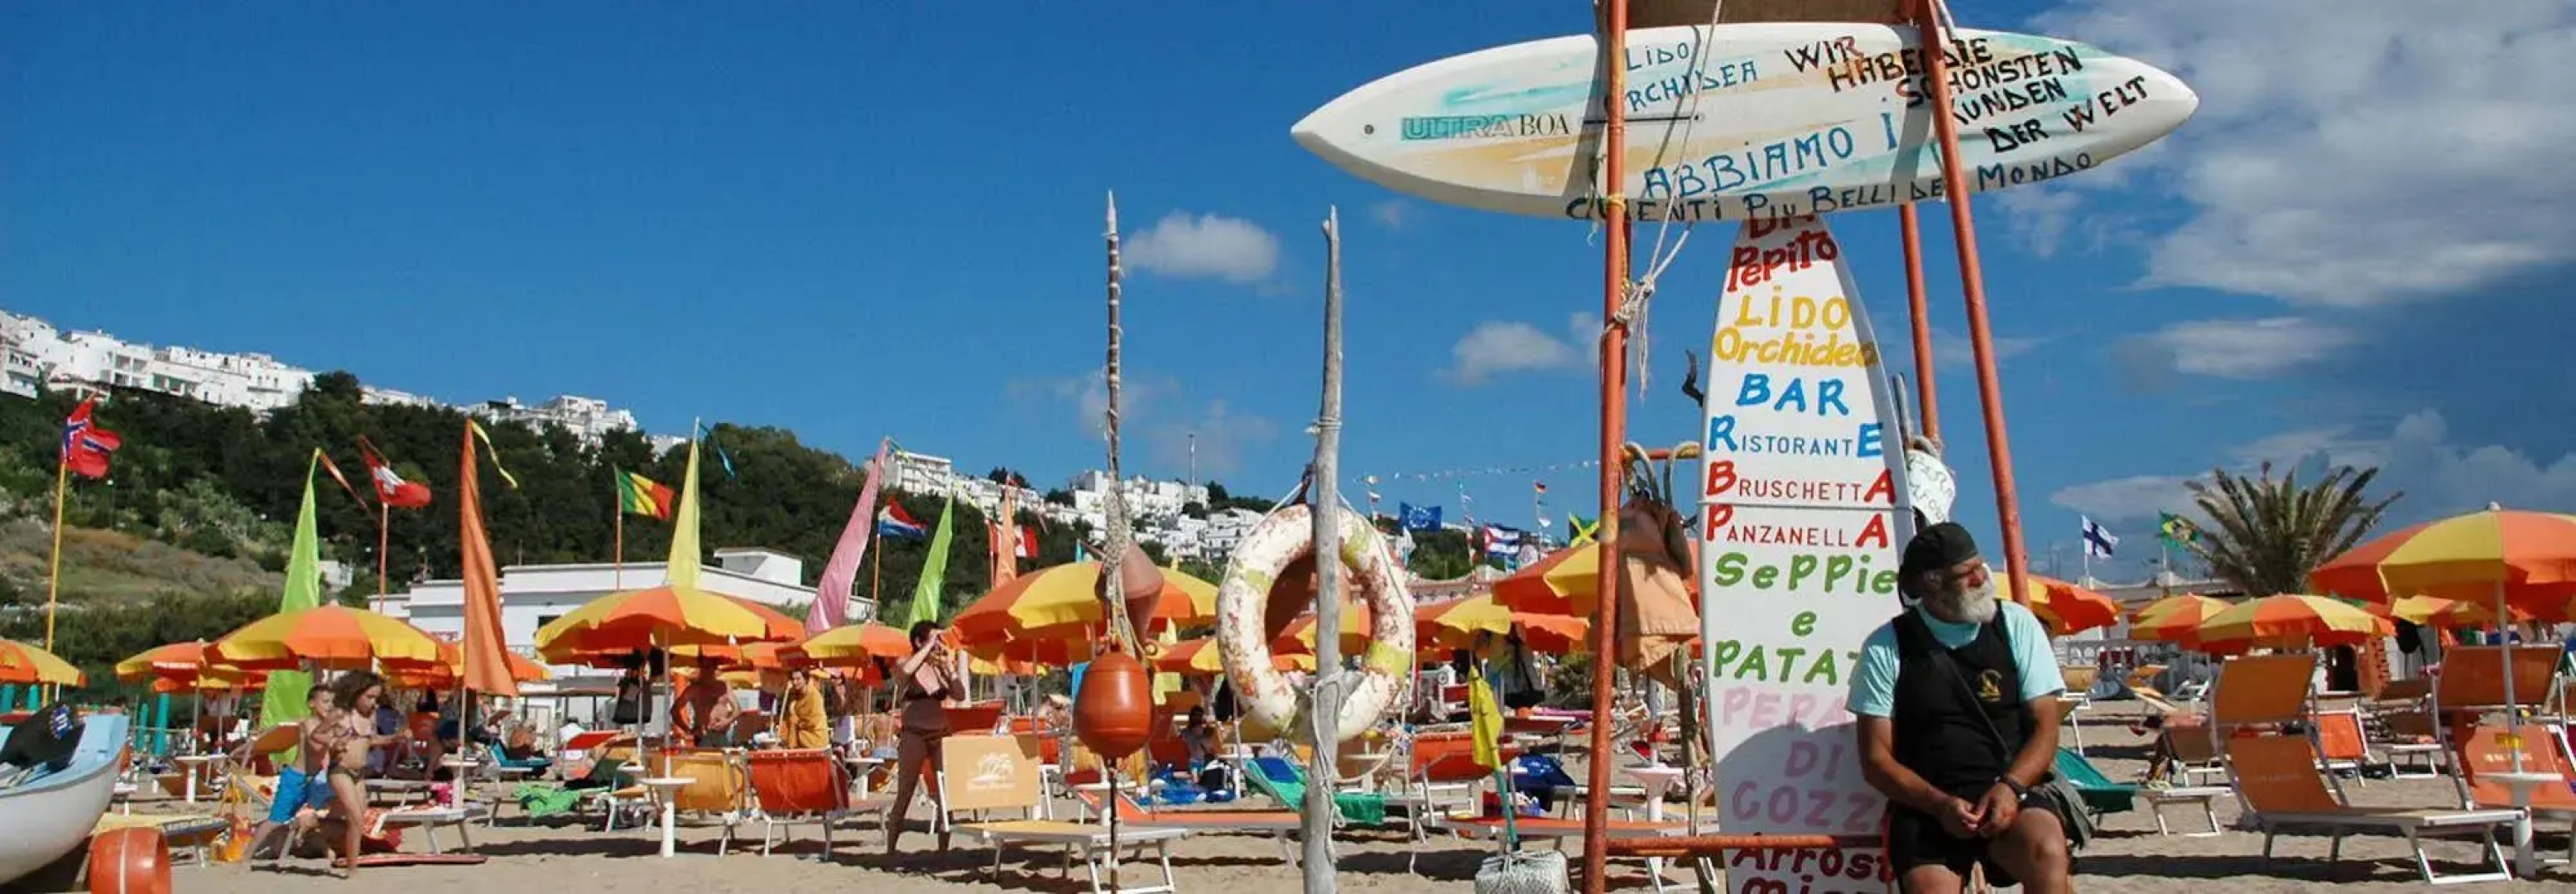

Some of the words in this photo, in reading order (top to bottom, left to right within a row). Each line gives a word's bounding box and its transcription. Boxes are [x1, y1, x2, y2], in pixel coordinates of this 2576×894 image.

[1785, 36, 1863, 74] WIR
[1828, 48, 1929, 93] HABE
[1604, 60, 1758, 112] RCHIDEA
[1400, 114, 1516, 141] ULTRA
[1518, 113, 1570, 136] BOA
[1984, 118, 2050, 155] DER
[2064, 75, 2150, 132] WELT
[1643, 127, 1854, 199] ABBIAMO
[1808, 184, 1896, 214] BELLI
[1910, 177, 1943, 201] DE
[1978, 152, 2092, 192] MONDO
[1713, 326, 1877, 367] Orchidea
[1736, 373, 1849, 416] BAR
[1708, 416, 1884, 459] RISTORANTE
[1706, 460, 1897, 506] BRUSCHETTA
[1705, 503, 1889, 550] PANZANELLA
[1785, 741, 1844, 783] DI
